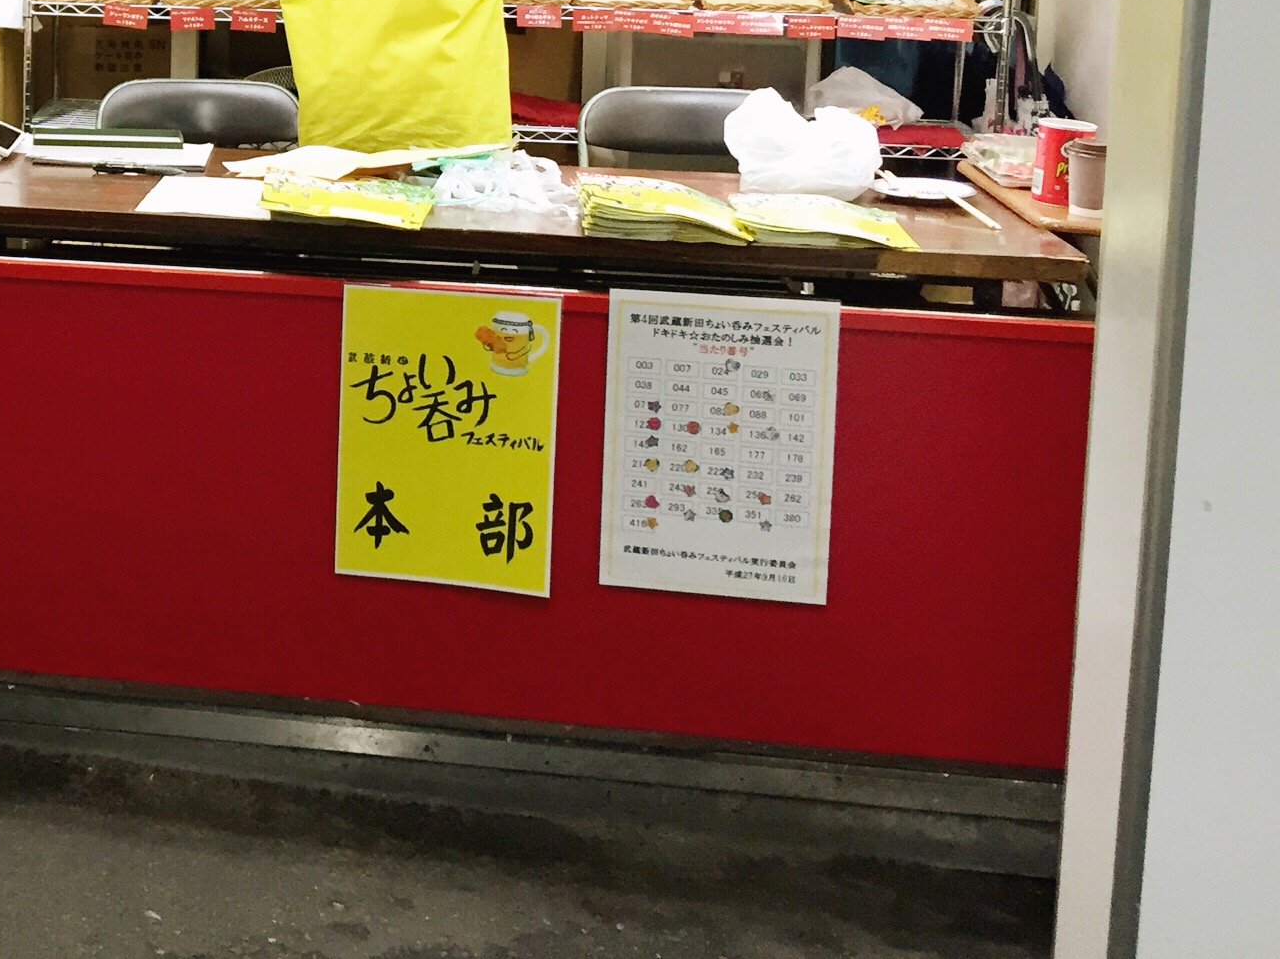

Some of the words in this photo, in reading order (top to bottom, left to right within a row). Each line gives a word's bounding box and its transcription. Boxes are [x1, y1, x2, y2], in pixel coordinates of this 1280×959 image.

[673, 363, 692, 374] 007
[750, 369, 769, 380] 029
[634, 379, 653, 391] 038
[672, 383, 691, 393] 044
[710, 386, 729, 397] 045
[349, 352, 498, 443] ちょい呑み
[633, 399, 650, 409] 07
[671, 403, 690, 413] 077
[788, 413, 805, 423] 101
[460, 430, 546, 452] フェスティバル
[710, 426, 727, 437] 134
[787, 433, 805, 443] 142
[670, 443, 688, 453] 162
[748, 450, 766, 460] 177
[631, 459, 649, 469] 21
[746, 470, 764, 481] 232
[631, 479, 648, 489] 241
[667, 502, 686, 513] 293
[744, 510, 762, 520] 351
